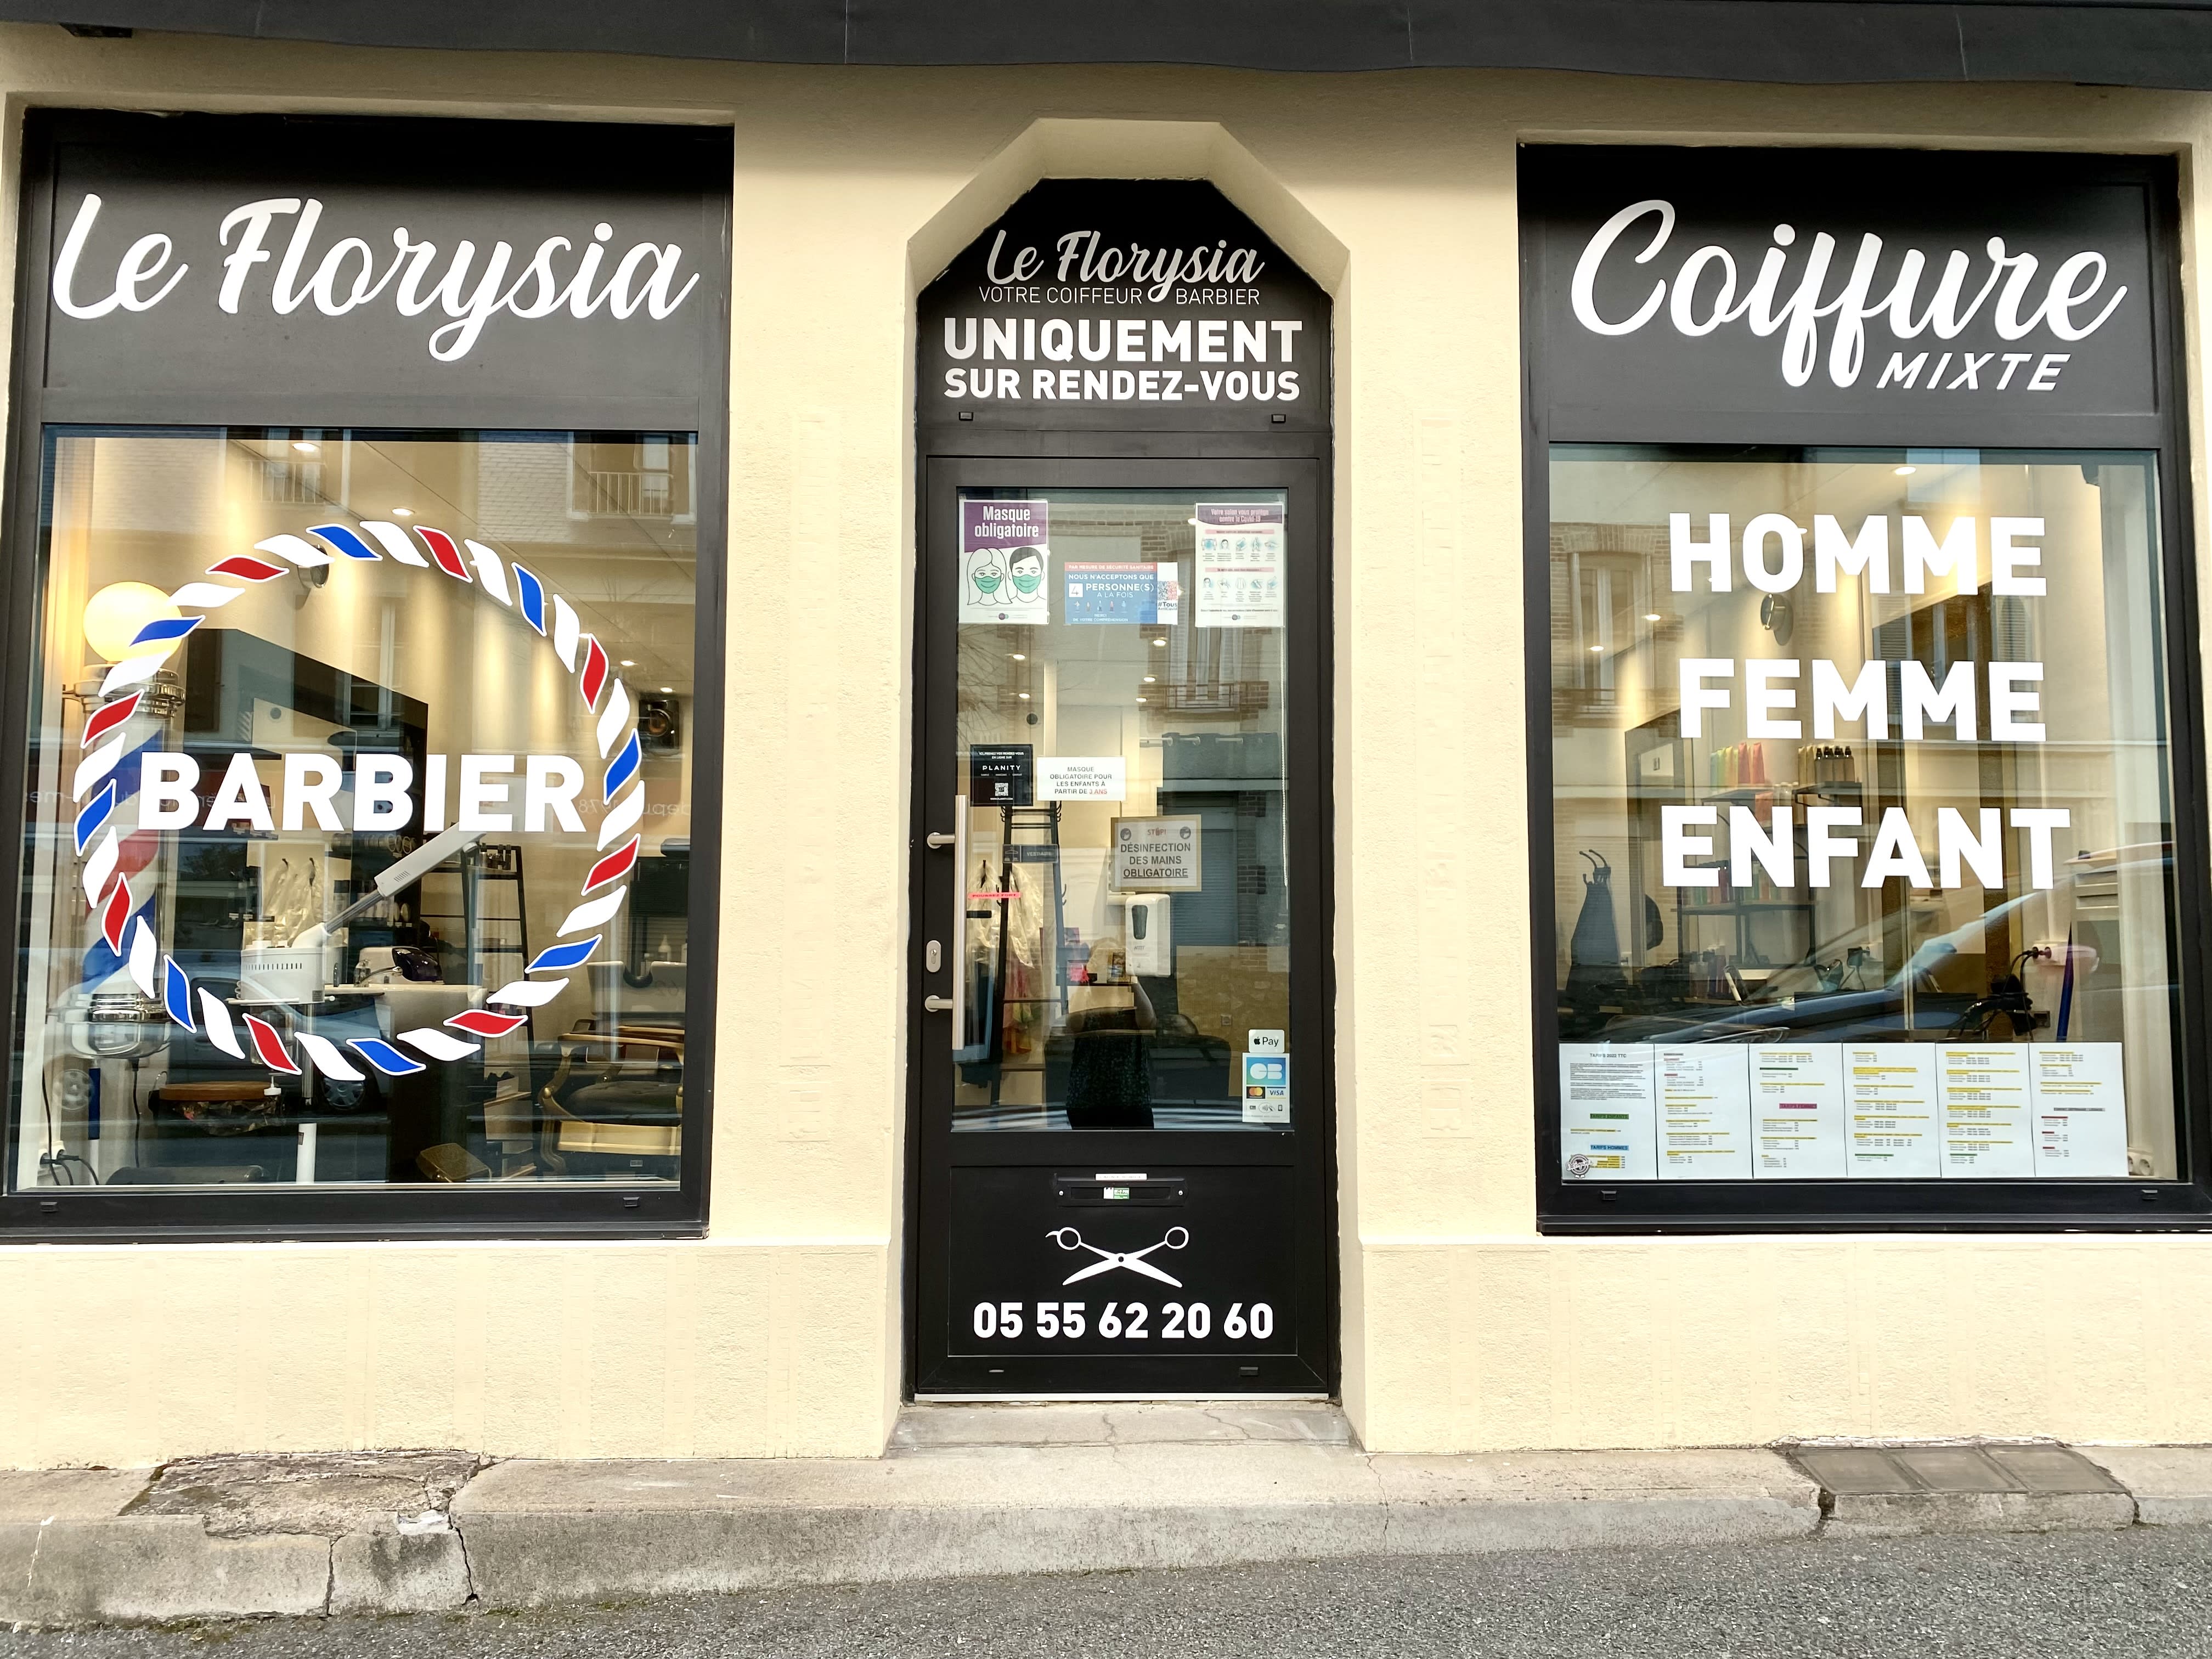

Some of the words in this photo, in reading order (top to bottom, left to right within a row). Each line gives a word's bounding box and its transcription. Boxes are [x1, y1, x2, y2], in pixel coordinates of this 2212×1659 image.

[52, 193, 189, 319] Le
[218, 198, 700, 362] Florysia
[986, 229, 1044, 283] Le
[1057, 230, 1265, 303] Florysia
[979, 286, 1041, 303] VOTRE
[1046, 286, 1142, 304] COIFFEUR
[1175, 288, 1260, 305] BARBIER
[1571, 199, 2128, 387] Coiffure
[944, 317, 1302, 363] UNIQUEMENT
[944, 368, 1022, 399] SUR
[1032, 369, 1300, 401] RENDEZ-VOUS
[1876, 351, 2071, 391] MIXTE
[974, 522, 1040, 539] obligatoire
[983, 505, 1031, 523] Masque
[1669, 512, 2047, 596] HOMME
[1070, 585, 1080, 596] 4
[1085, 583, 1154, 592] PERSONNE(S)
[1679, 658, 2046, 742] FEMME
[137, 752, 586, 833] BARBIER
[1120, 842, 1191, 853] DÉSINFECTION
[1129, 856, 1148, 865] DES
[1151, 855, 1182, 865] MAINS
[1661, 805, 2071, 890] ENFANT
[1123, 868, 1188, 878] OBLIGATOIRE
[1262, 1036, 1279, 1047] Pay
[1250, 1063, 1283, 1080] CB
[973, 1302, 1023, 1339] 05
[1036, 1302, 1086, 1339] 55
[1098, 1302, 1148, 1339] 62
[1161, 1302, 1211, 1339] 20
[1223, 1302, 1274, 1339] 60
